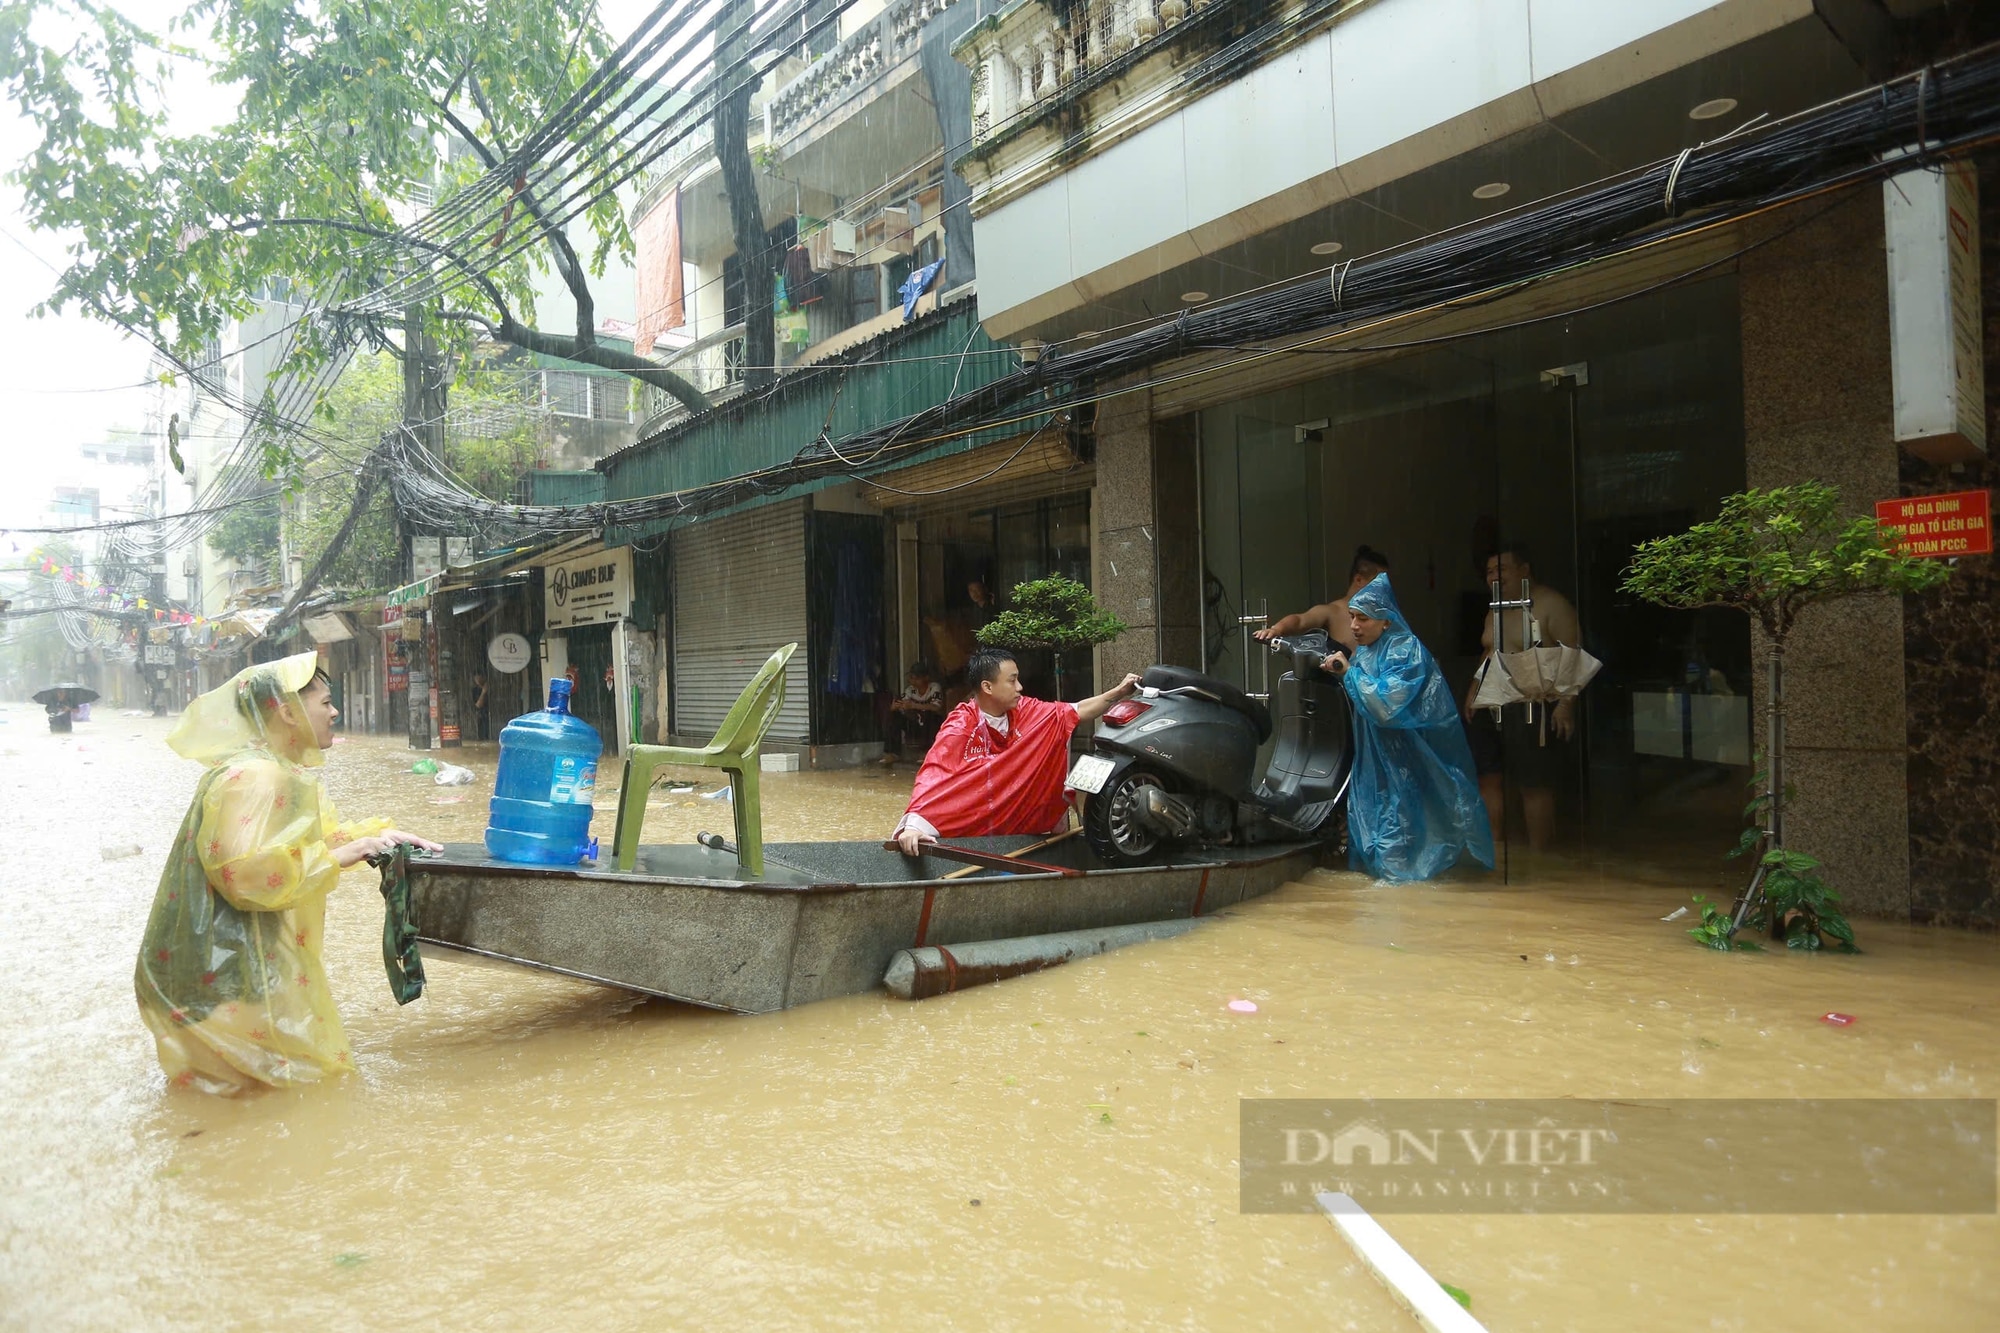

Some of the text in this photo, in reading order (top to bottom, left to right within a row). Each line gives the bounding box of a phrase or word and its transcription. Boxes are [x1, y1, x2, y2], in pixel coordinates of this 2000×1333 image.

[1902, 499, 1959, 518] HỘ GIA ĐÌNH
[1910, 523, 1926, 535] GIA
[1928, 517, 1940, 533] TỔ
[1942, 517, 1964, 532] LIÊN
[1967, 516, 1984, 529] GIA
[1913, 539, 1938, 553] TOÀN
[1941, 538, 1967, 551] PCCC
